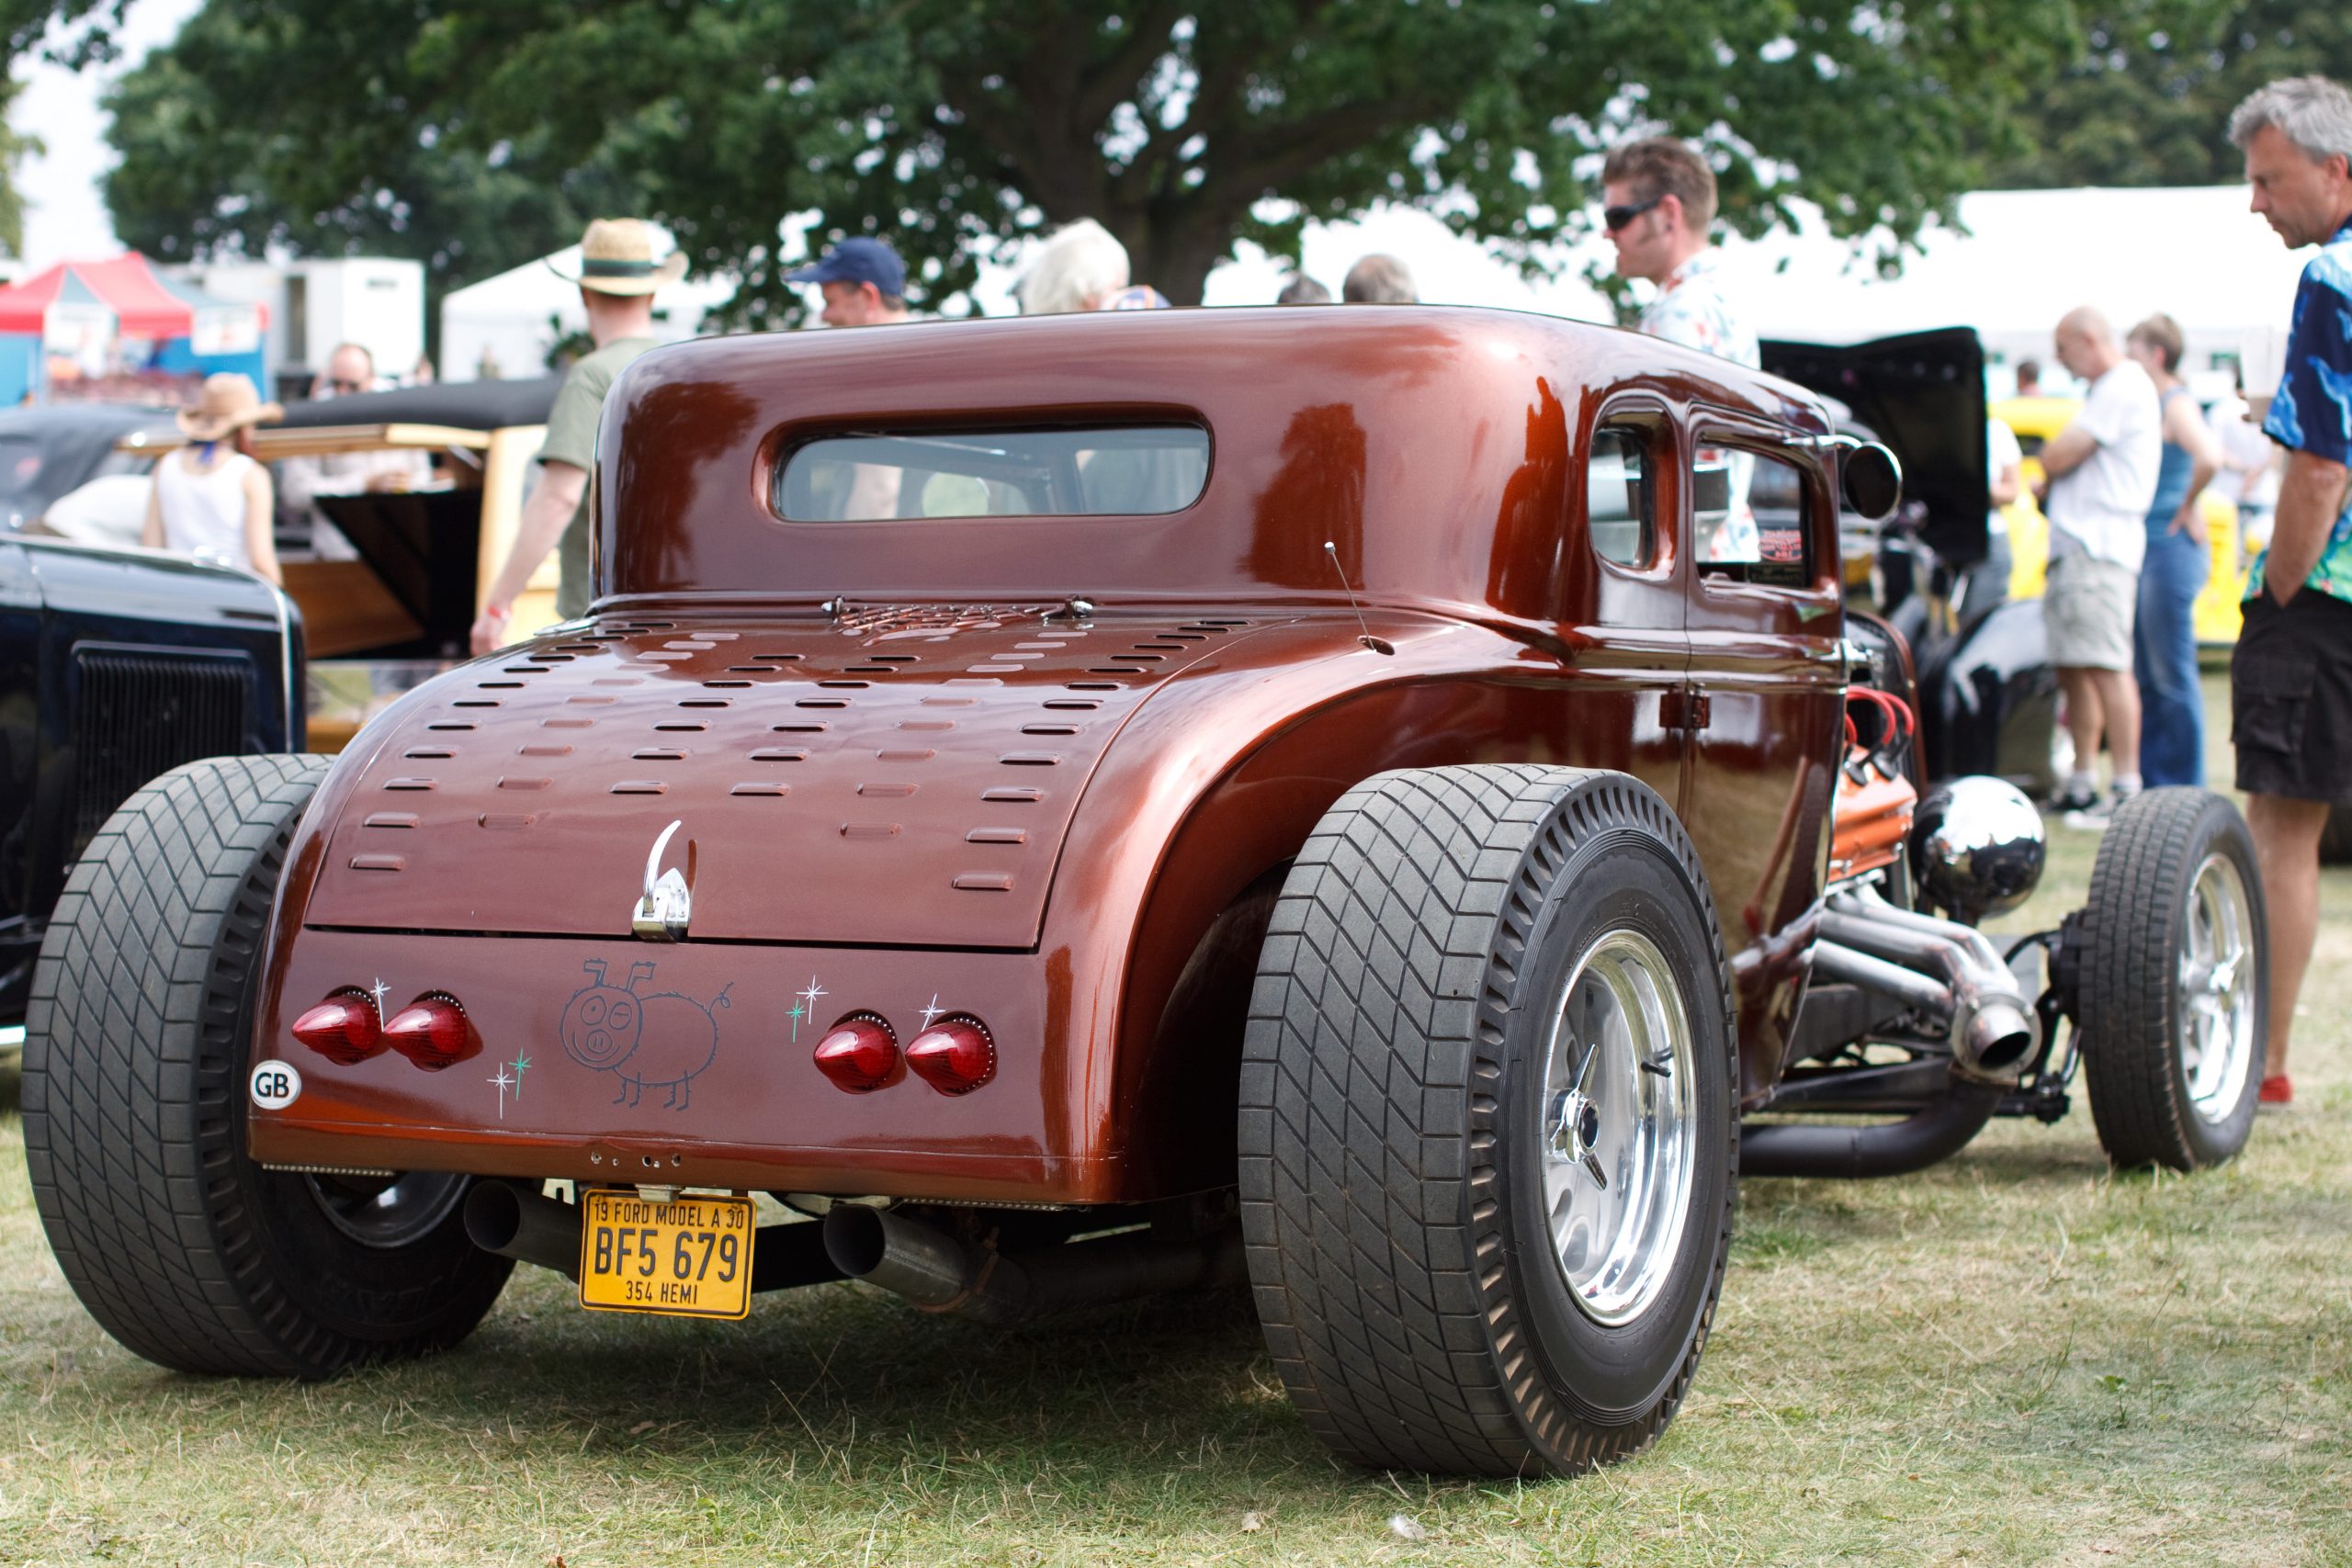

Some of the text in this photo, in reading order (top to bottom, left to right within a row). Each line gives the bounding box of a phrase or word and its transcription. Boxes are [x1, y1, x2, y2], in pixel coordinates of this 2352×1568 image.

[255, 1072, 289, 1098] GB
[594, 1203, 743, 1229] 19 FORD MODEL A 30
[594, 1226, 739, 1282] BF5 679
[626, 1281, 697, 1304] 354 HEMI
